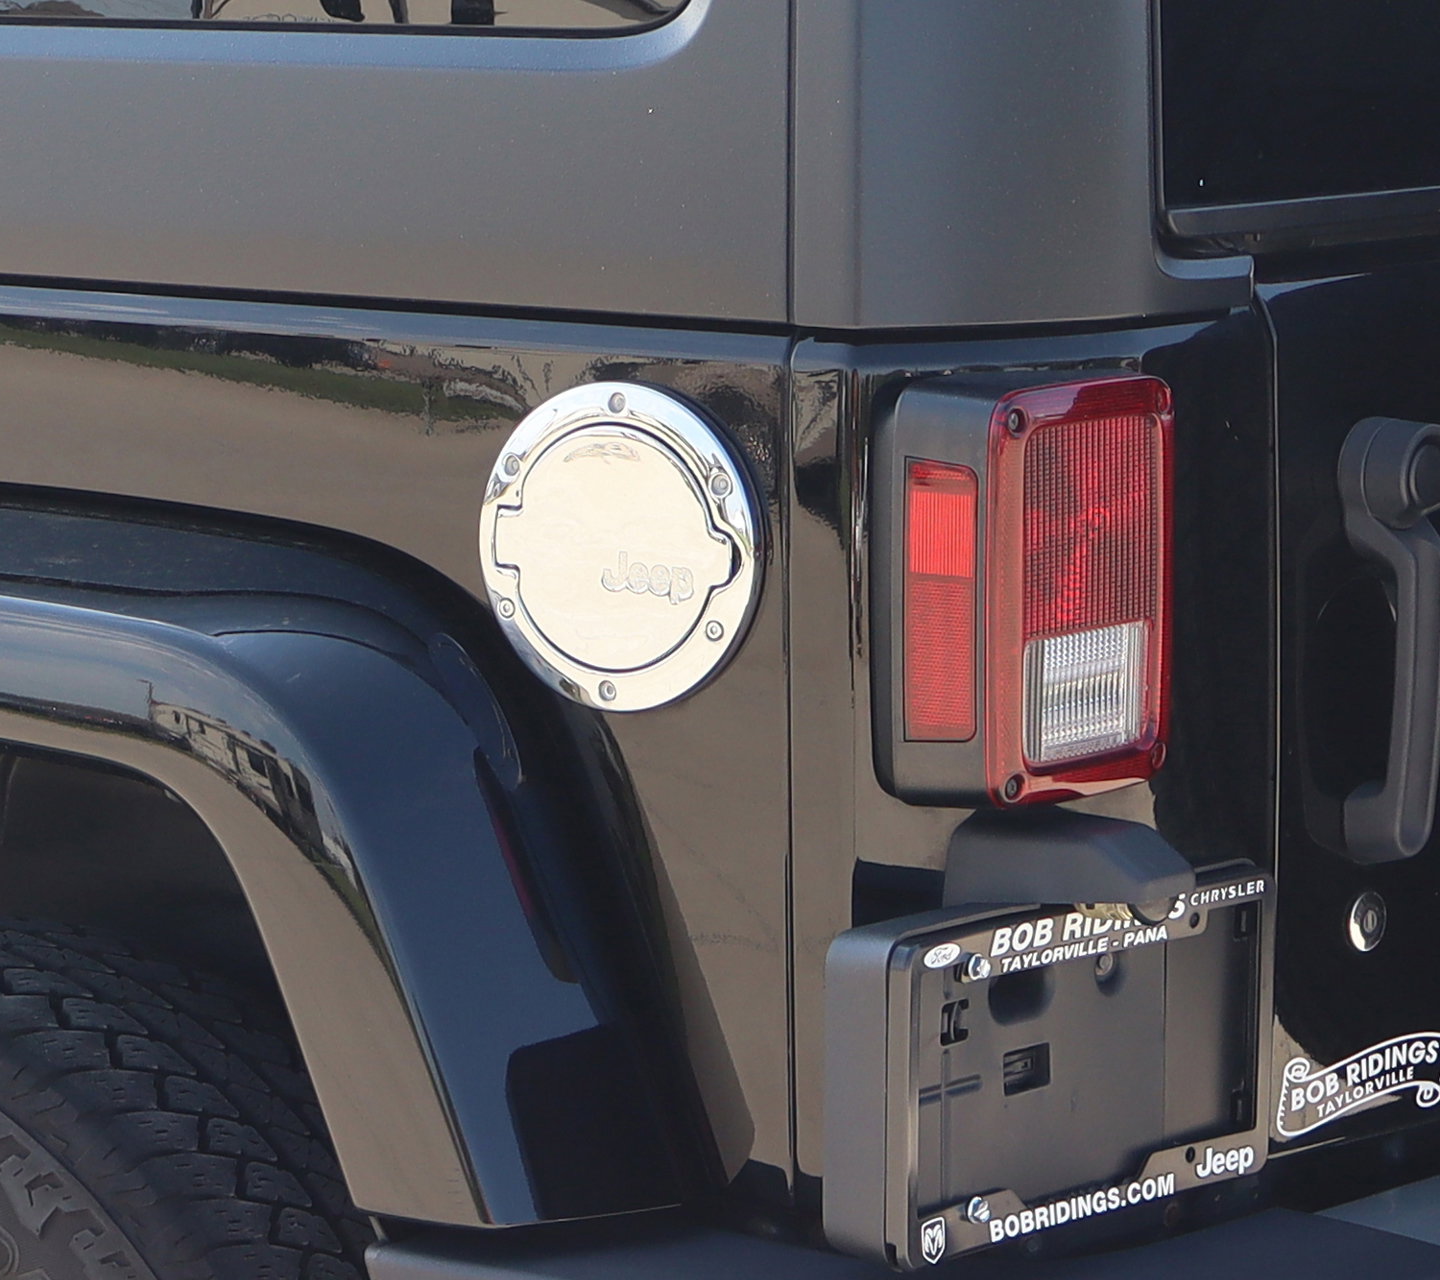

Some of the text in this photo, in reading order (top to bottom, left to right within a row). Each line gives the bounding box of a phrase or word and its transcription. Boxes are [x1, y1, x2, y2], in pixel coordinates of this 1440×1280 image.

[601, 550, 694, 605] Jeep
[1190, 879, 1266, 907] CHRYSLER
[989, 920, 1054, 958] BOB
[1001, 936, 1109, 974] TAYLORVILLE
[1123, 925, 1168, 948] PANA
[1291, 1040, 1440, 1111] BOB RIDINGS
[1317, 1066, 1414, 1118] TAYLORVILLE
[1196, 1145, 1255, 1178] Jeep
[989, 1173, 1175, 1243] BOBRIDINGS.COM
